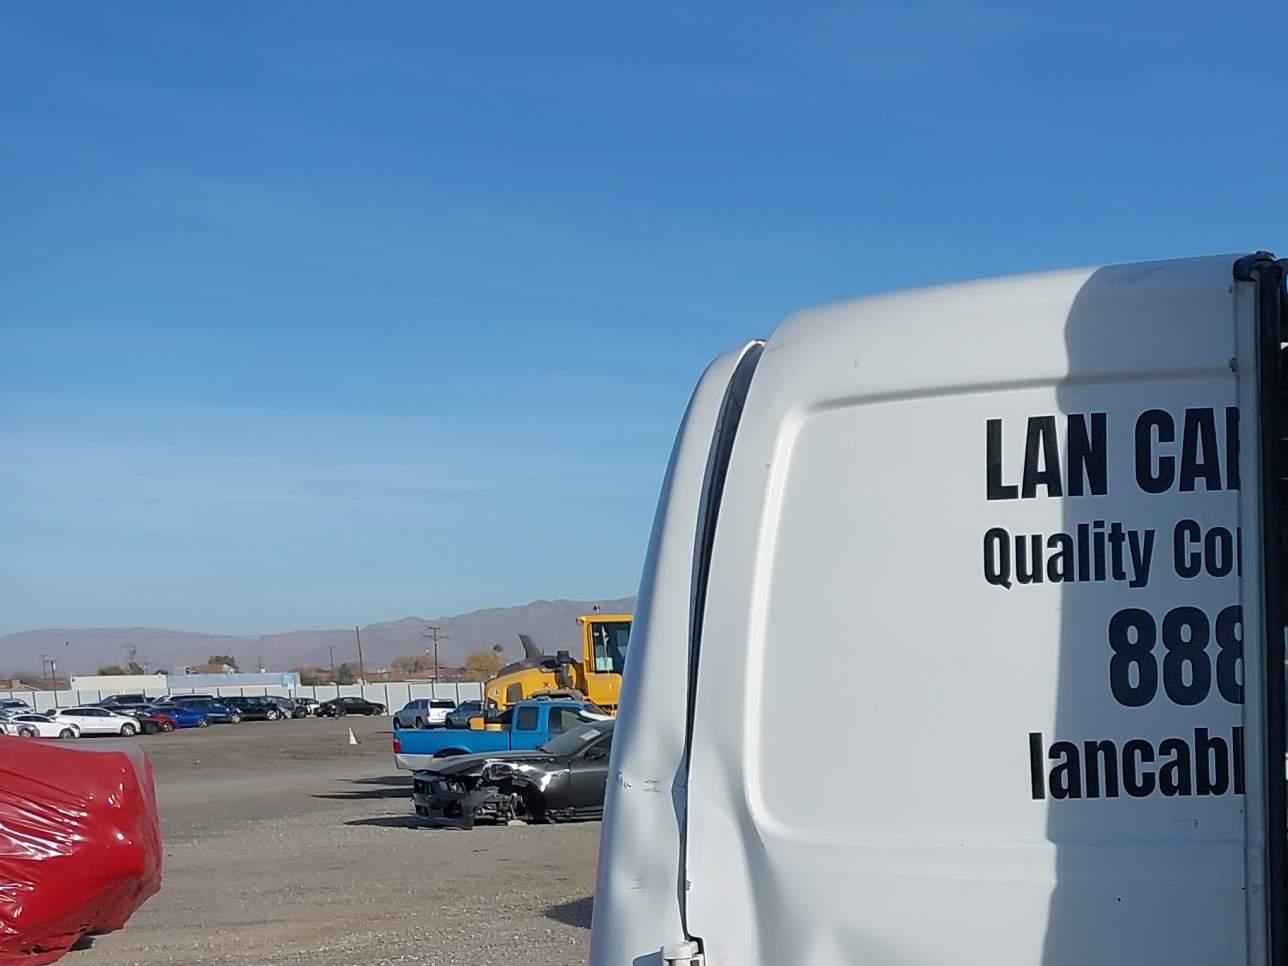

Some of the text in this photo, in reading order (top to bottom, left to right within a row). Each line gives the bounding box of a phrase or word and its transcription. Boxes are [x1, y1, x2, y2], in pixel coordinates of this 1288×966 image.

[986, 413, 1107, 500] LAN
[983, 519, 1242, 588] Quality Co
[1029, 727, 1246, 800] lancabl
